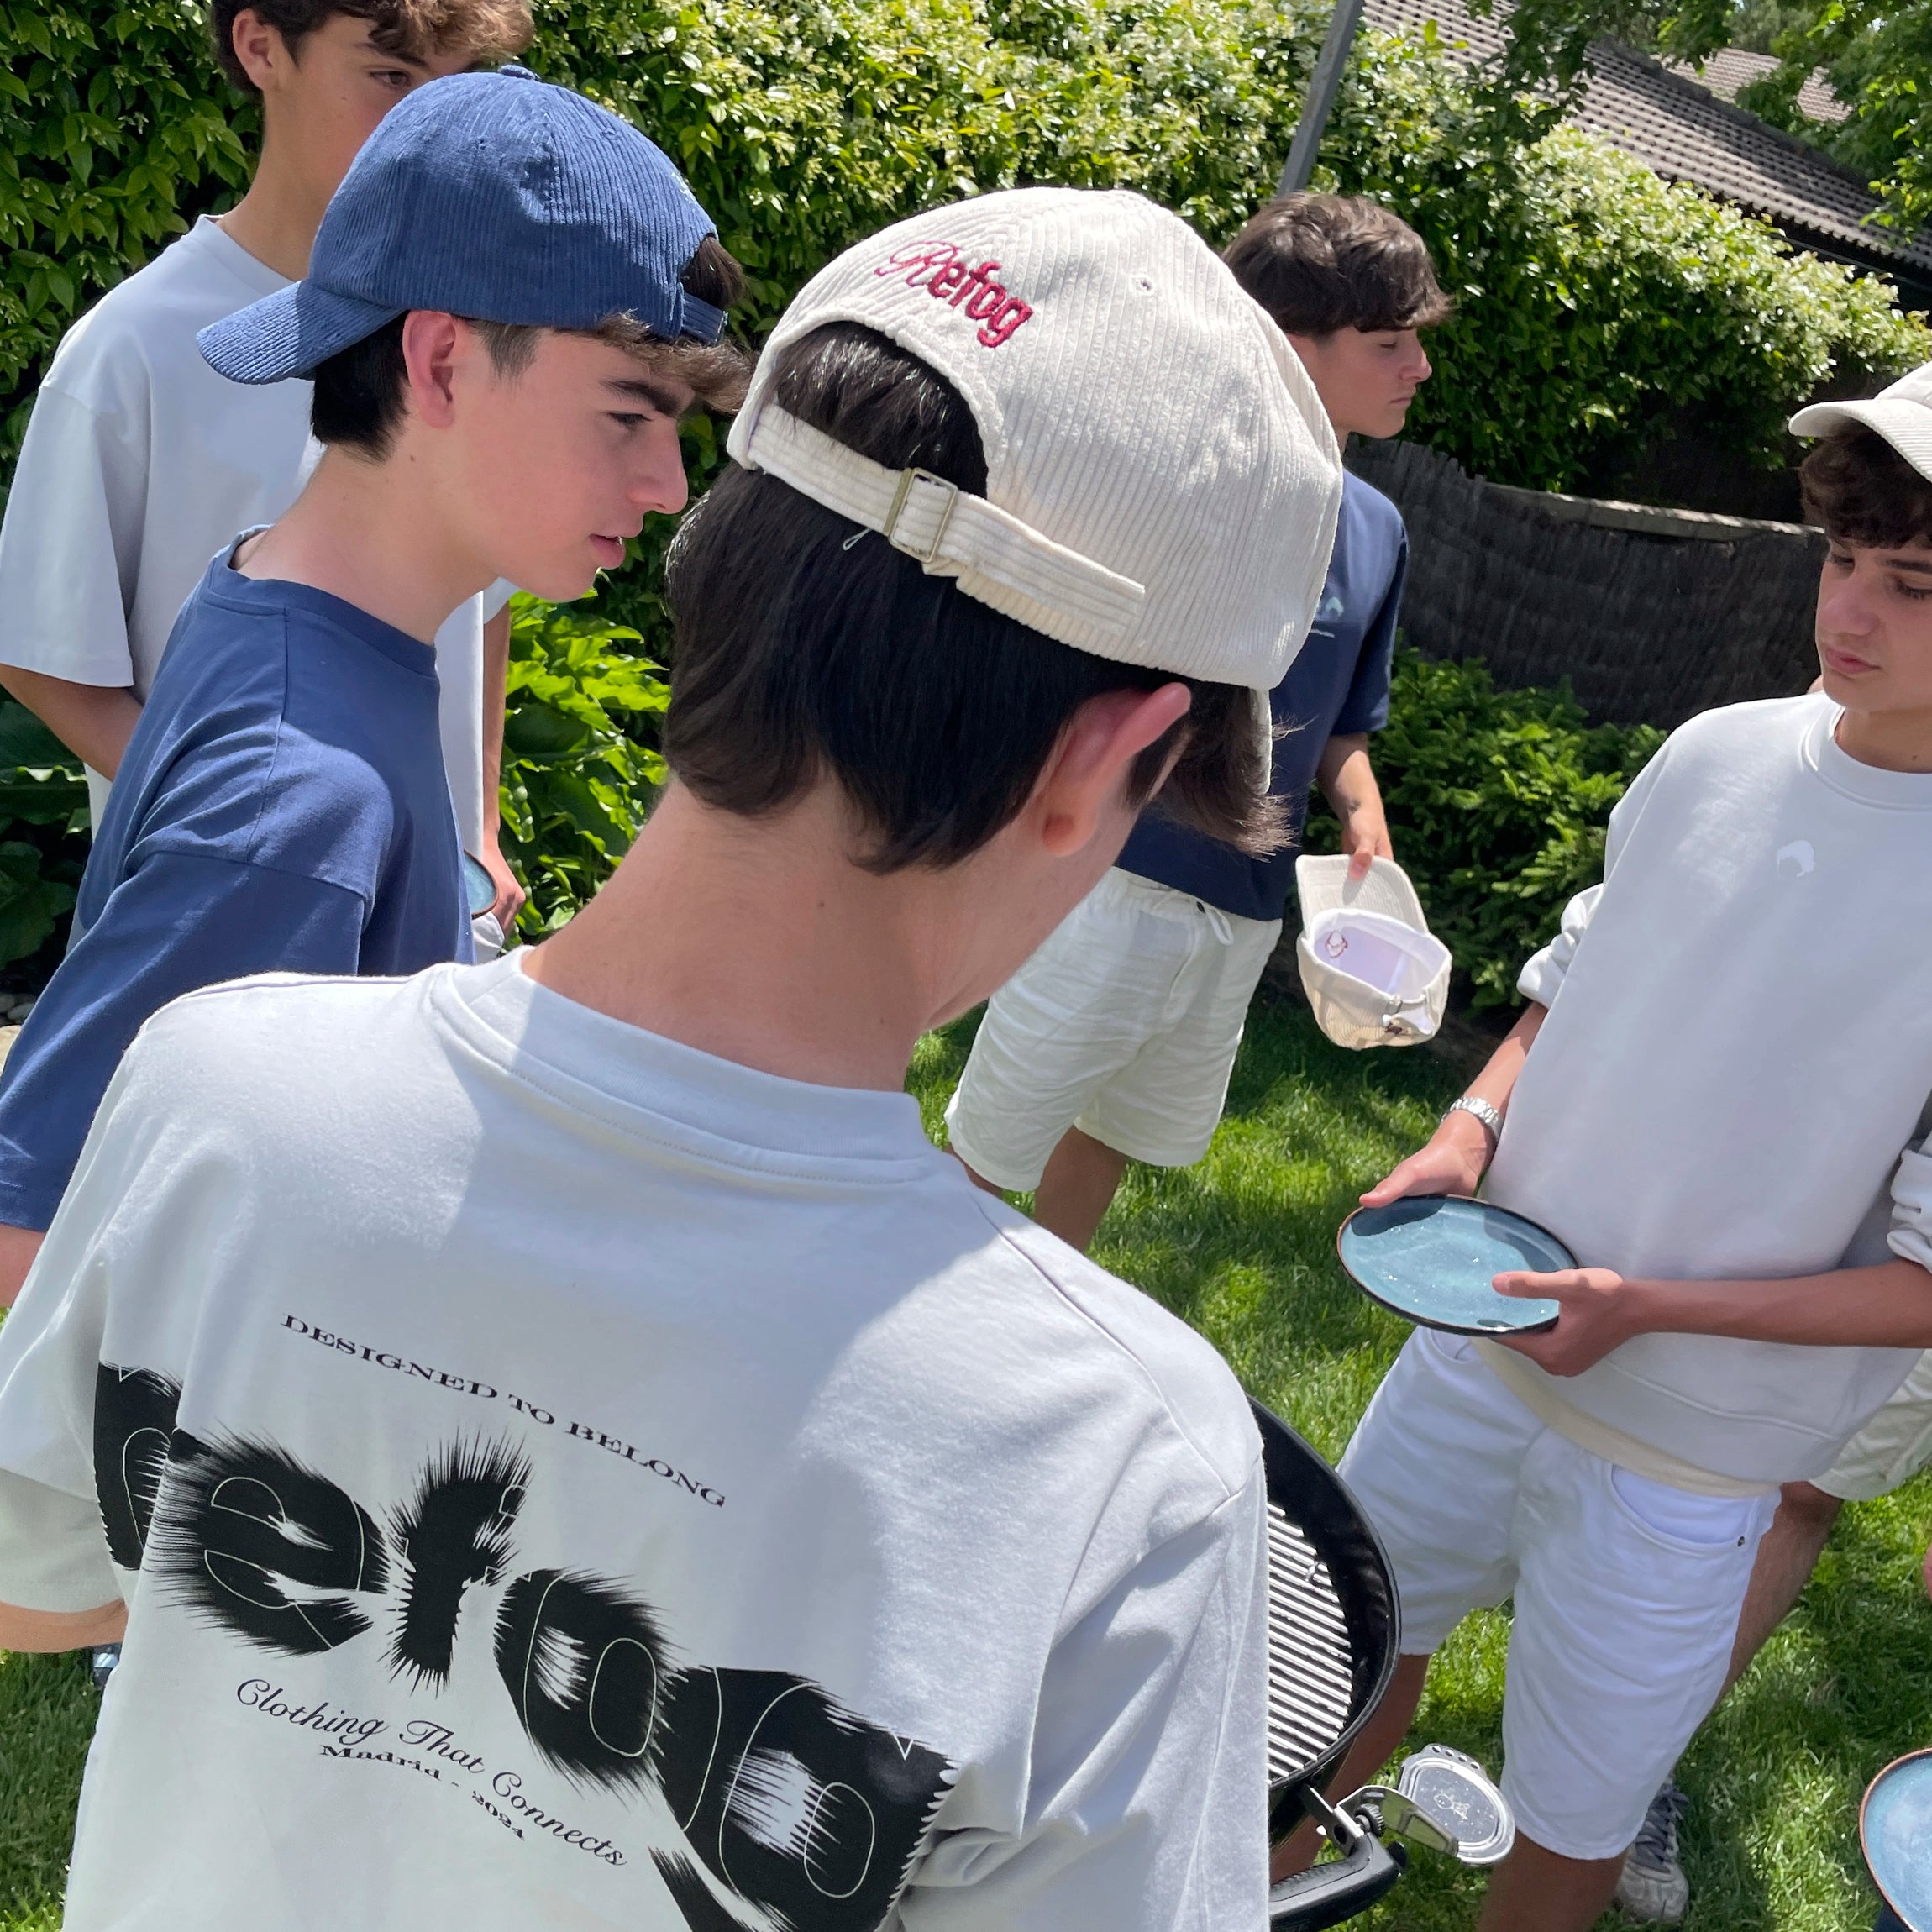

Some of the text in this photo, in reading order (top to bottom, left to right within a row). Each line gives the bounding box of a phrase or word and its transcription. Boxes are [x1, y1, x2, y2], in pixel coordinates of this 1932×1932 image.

[874, 240, 1033, 348] Refog
[281, 1315, 725, 1507] DESIGNED TO BELONG
[237, 1678, 627, 1866] Clothing That Connects
[320, 1744, 441, 1781] Madrid
[472, 1790, 525, 1841] 2024
